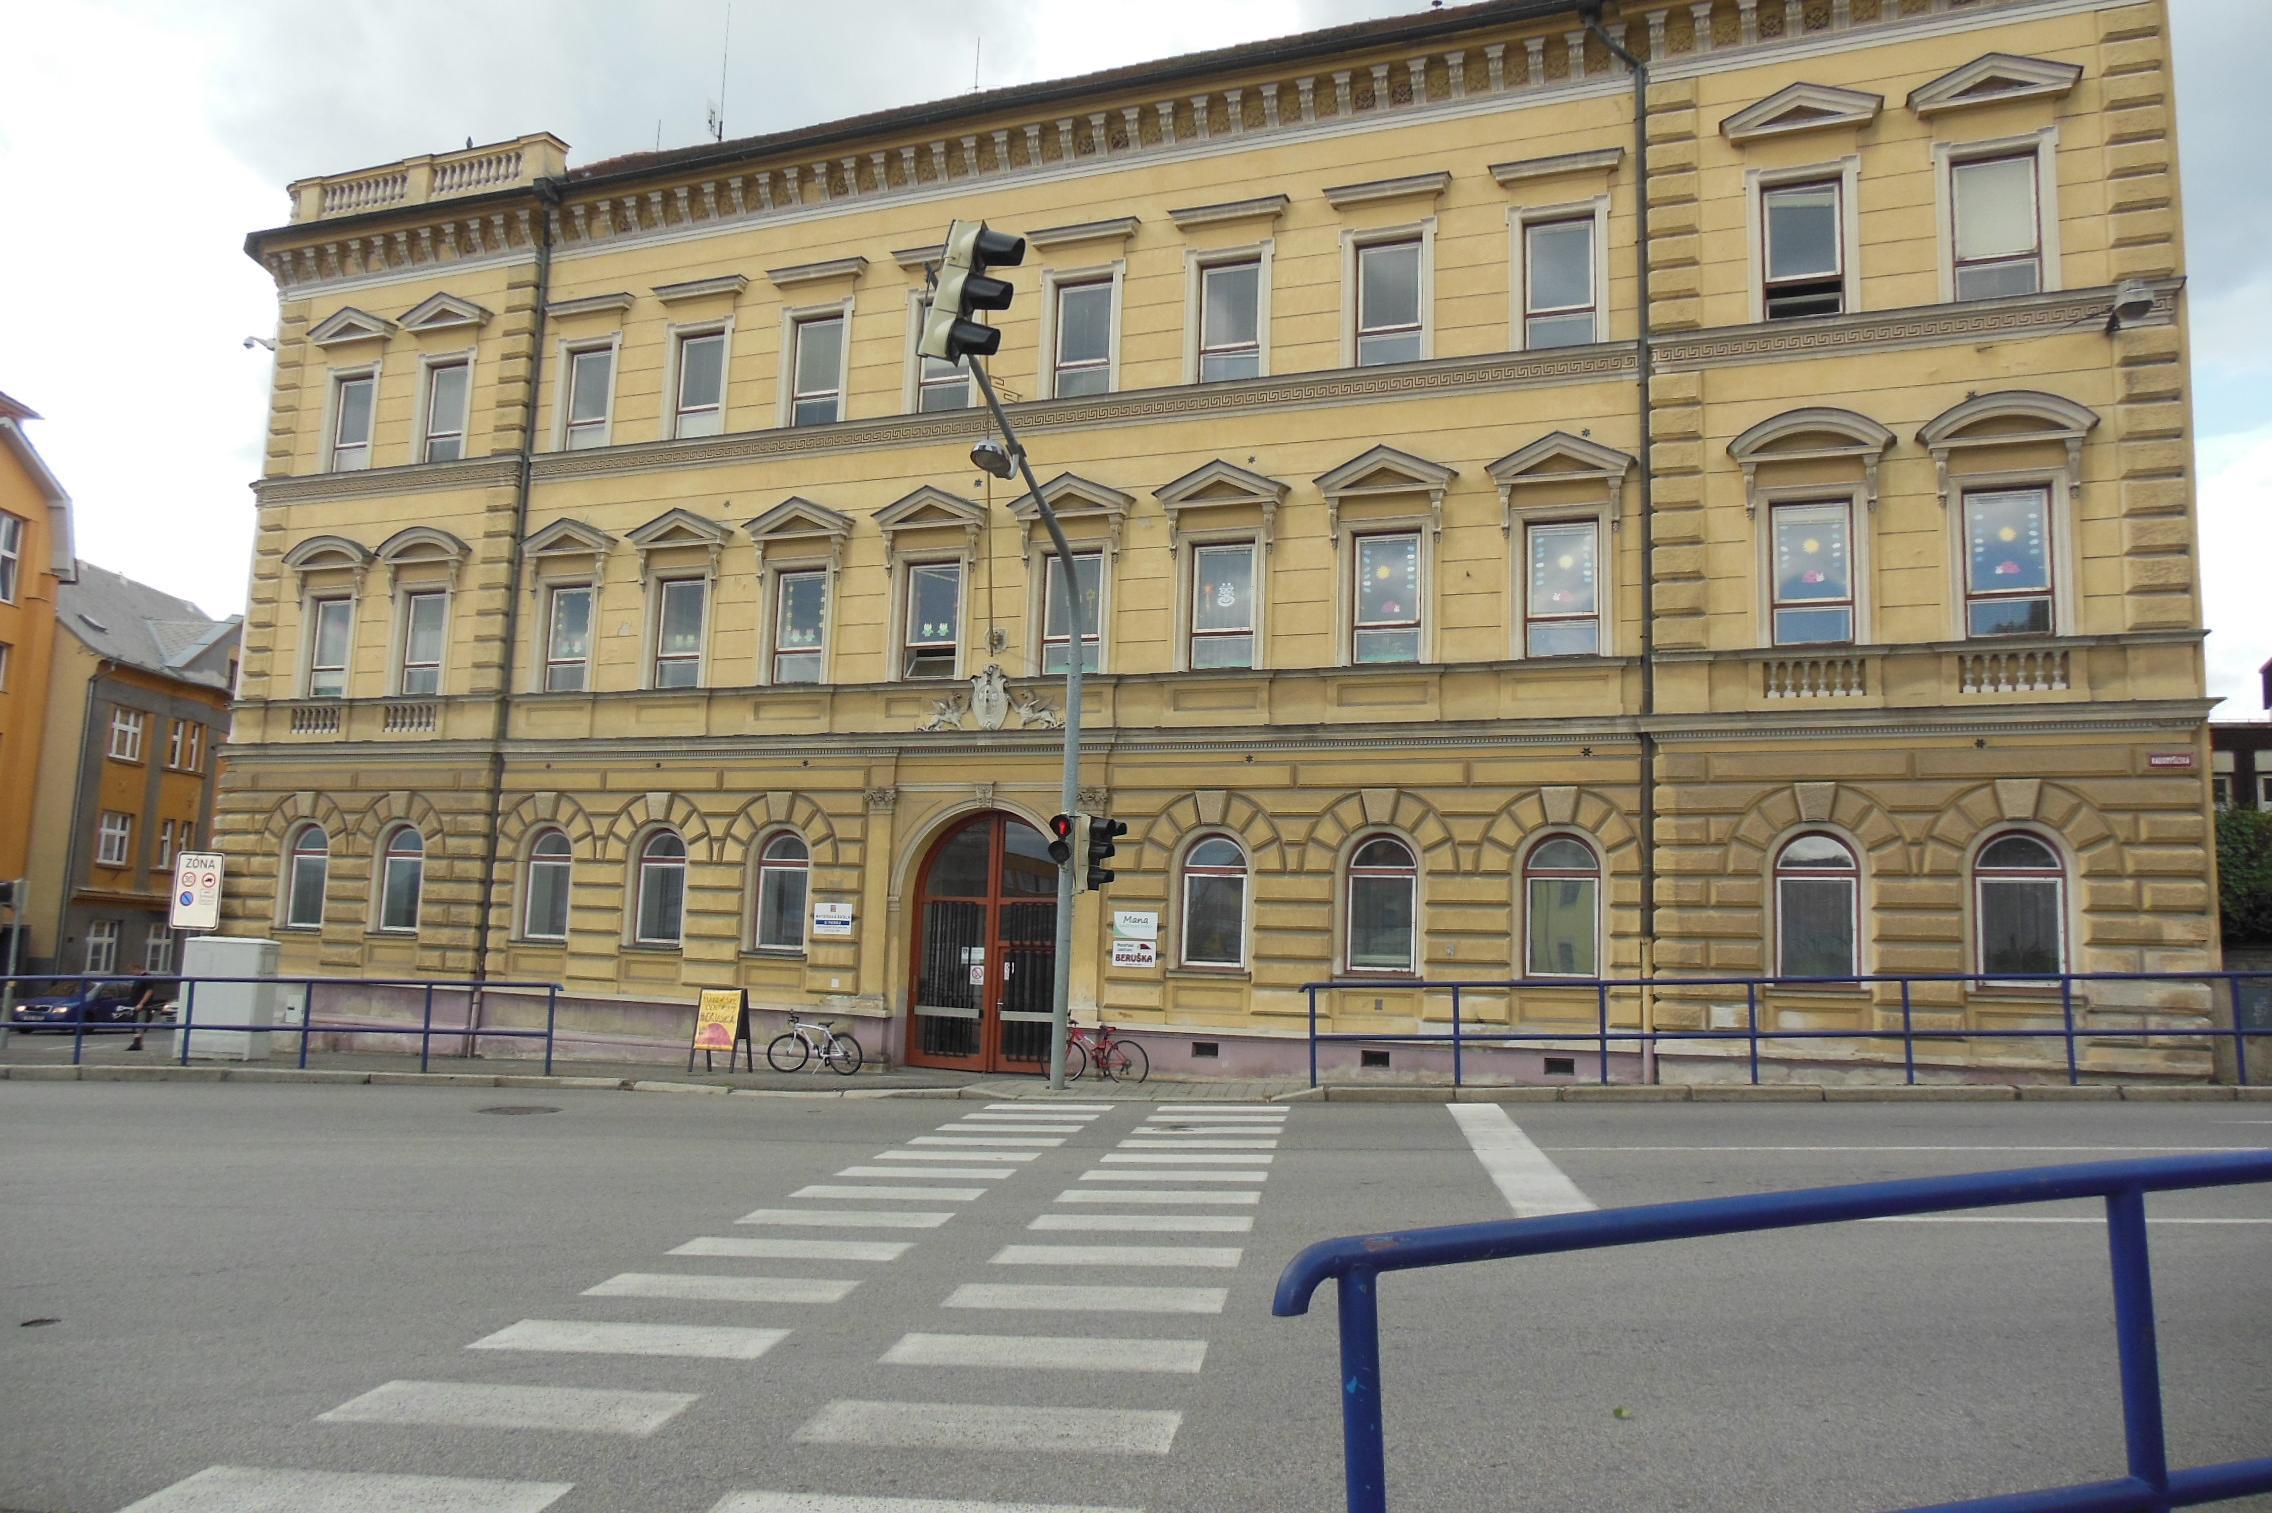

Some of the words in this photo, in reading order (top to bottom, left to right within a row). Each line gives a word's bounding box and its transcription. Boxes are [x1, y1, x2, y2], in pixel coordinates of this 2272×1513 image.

[185, 856, 215, 869] ZÓNA
[1122, 915, 1149, 925] Mana
[1115, 952, 1153, 963] BERUŠKA
